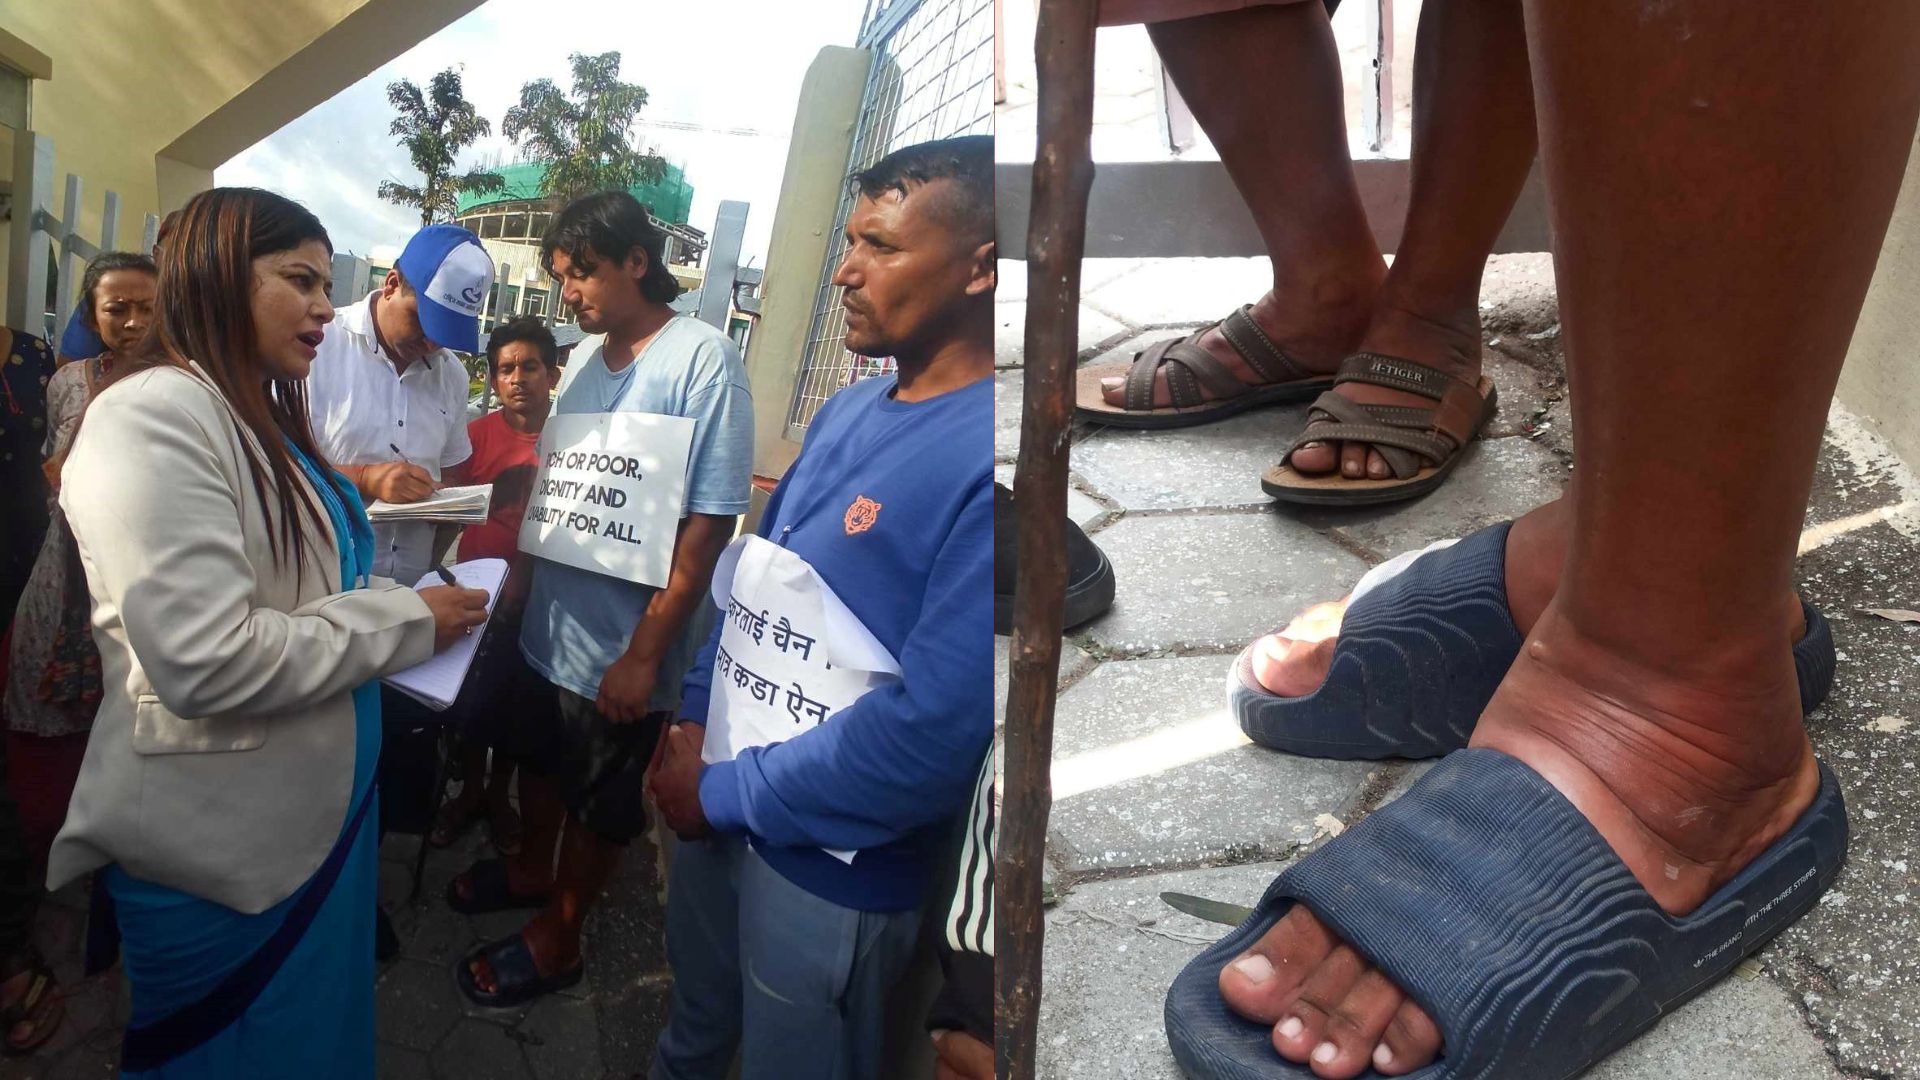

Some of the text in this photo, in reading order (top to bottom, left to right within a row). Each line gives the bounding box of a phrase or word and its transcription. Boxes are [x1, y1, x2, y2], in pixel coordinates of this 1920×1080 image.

[566, 452, 587, 471] OR
[586, 453, 643, 481] POOR,
[539, 479, 627, 508] DIGNITY AND
[566, 512, 600, 535] FOR
[602, 521, 642, 545] ALL.
[772, 616, 816, 661] चैन
[733, 662, 780, 706] कडा
[786, 682, 831, 727] ऐन
[1704, 948, 1719, 962] THE
[1758, 901, 1773, 916] THE
[1771, 886, 1793, 906] THREE
[1793, 866, 1817, 890] STRIPES
